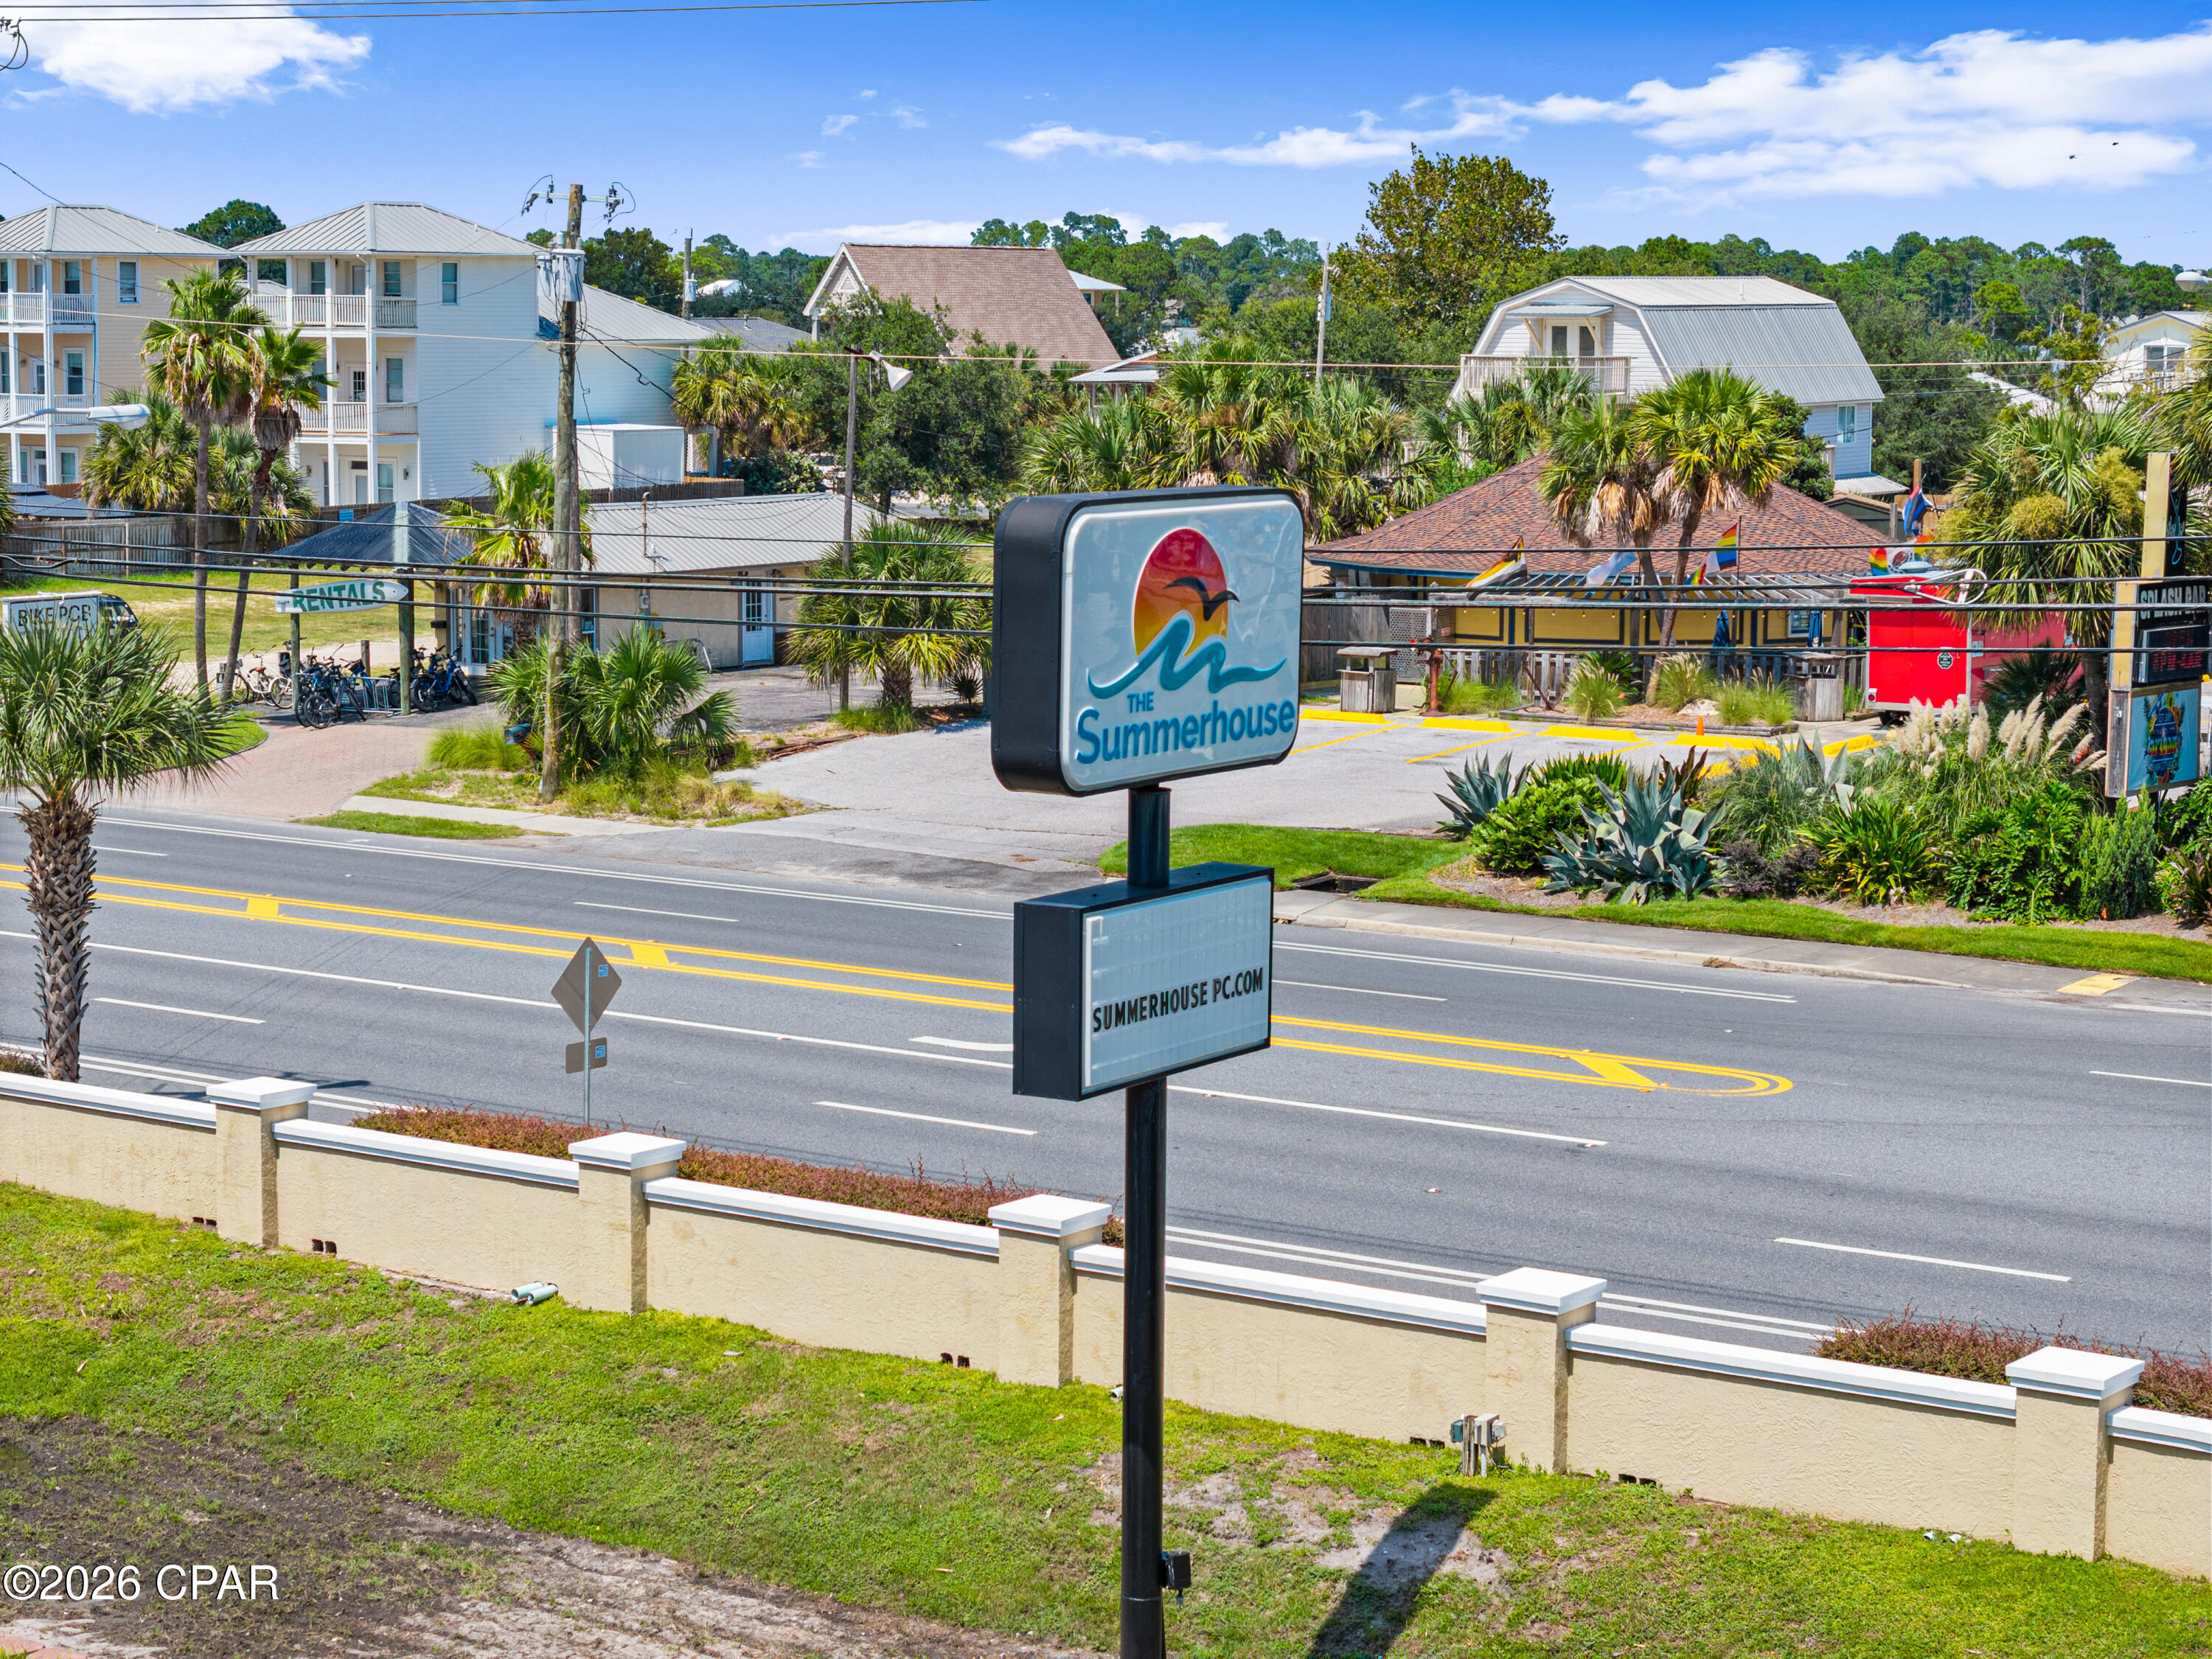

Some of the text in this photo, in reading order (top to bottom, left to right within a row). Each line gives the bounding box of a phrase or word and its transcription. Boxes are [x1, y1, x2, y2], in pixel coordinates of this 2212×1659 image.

[292, 581, 386, 612] RENTALS
[2140, 585, 2206, 619] SPLASH BAR
[18, 604, 91, 627] BIKE PCB
[1127, 691, 1154, 714] THE
[1076, 699, 1295, 765] Summerhouse
[1093, 967, 1263, 1033] SUMMERHOUSE PC.COM
